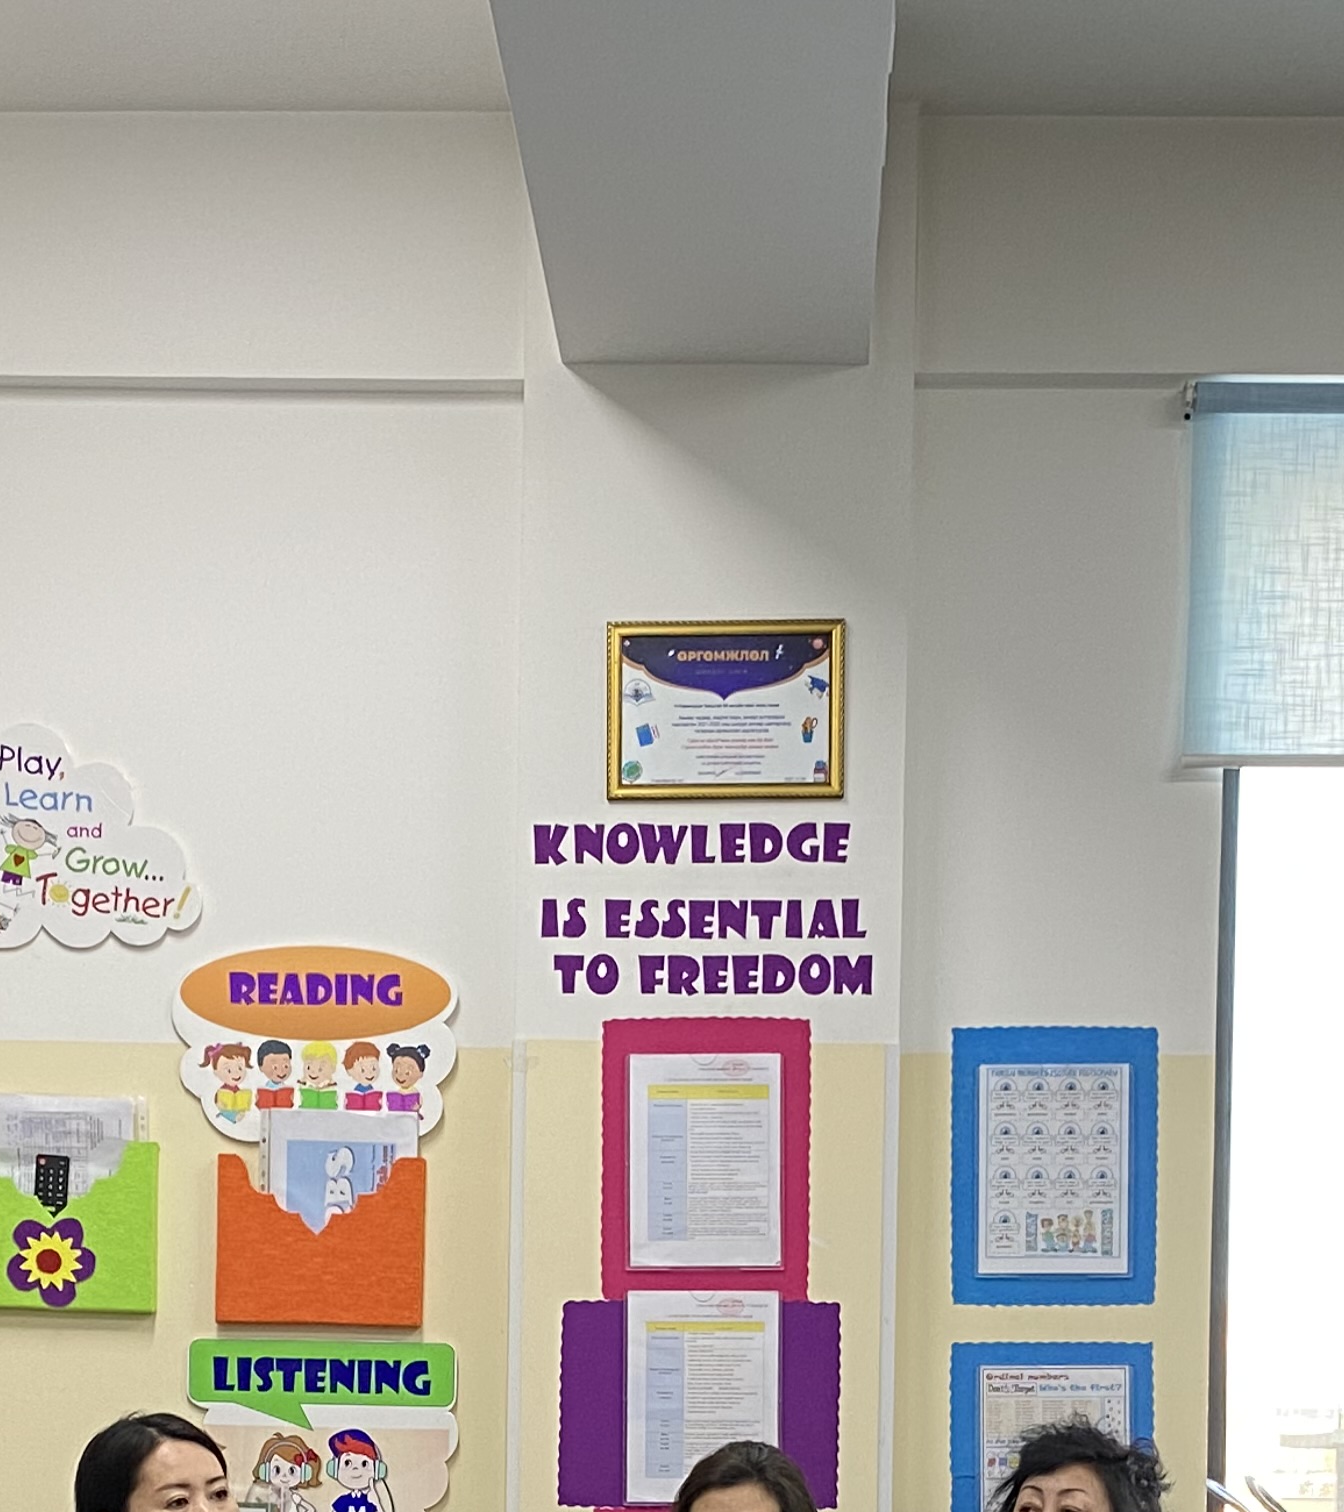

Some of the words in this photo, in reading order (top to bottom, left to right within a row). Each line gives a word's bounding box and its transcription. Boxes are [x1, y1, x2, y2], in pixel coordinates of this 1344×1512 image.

[4, 782, 93, 812] Learn
[66, 823, 103, 838] and
[532, 822, 851, 865] KNOWLEDGE
[64, 847, 164, 882] Grow...
[540, 898, 587, 938] IS
[605, 898, 868, 939] ESSENTIAL
[228, 971, 403, 1007] READING
[553, 953, 619, 995] TO
[638, 953, 873, 996] FREEDOM
[212, 1356, 431, 1396] LISTENING
